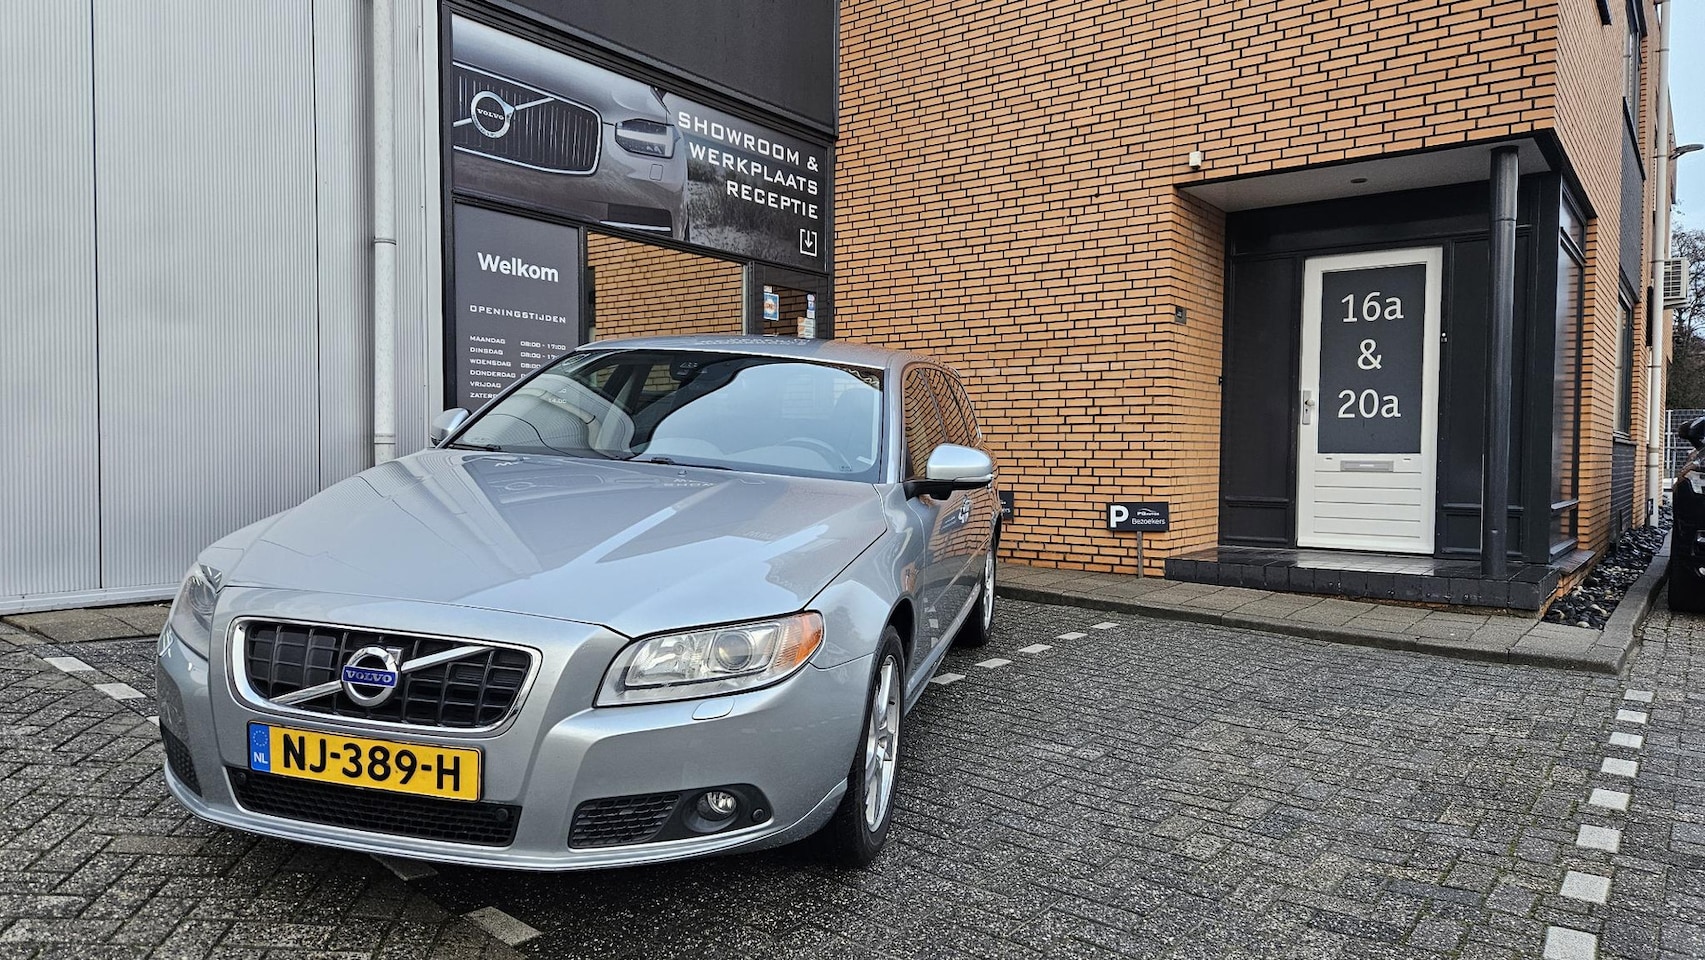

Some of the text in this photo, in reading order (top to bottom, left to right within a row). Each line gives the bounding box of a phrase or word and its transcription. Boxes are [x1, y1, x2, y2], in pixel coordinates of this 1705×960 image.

[477, 108, 505, 121] VOLVO
[678, 111, 819, 172] SHOWROOM &
[689, 141, 819, 196] WERKPLAATS
[726, 180, 819, 219] RECEPTIE
[477, 252, 559, 283] Welkom
[469, 304, 567, 324] OPENINGSTIJDEN
[1341, 291, 1404, 323] 16a
[469, 335, 506, 345] MAANDAG
[469, 346, 504, 356] DINSDAG
[1357, 339, 1382, 370] &
[469, 358, 512, 367] WOENSDAG
[469, 369, 516, 379] DONDERDAG
[469, 381, 502, 389] VRIJDAG
[1337, 389, 1401, 419] 20a
[1110, 504, 1129, 528] P
[1131, 517, 1166, 525] Bezoekers
[345, 669, 393, 684] VOLVO
[253, 751, 269, 764] NL
[282, 733, 461, 792] NJ-389-H
